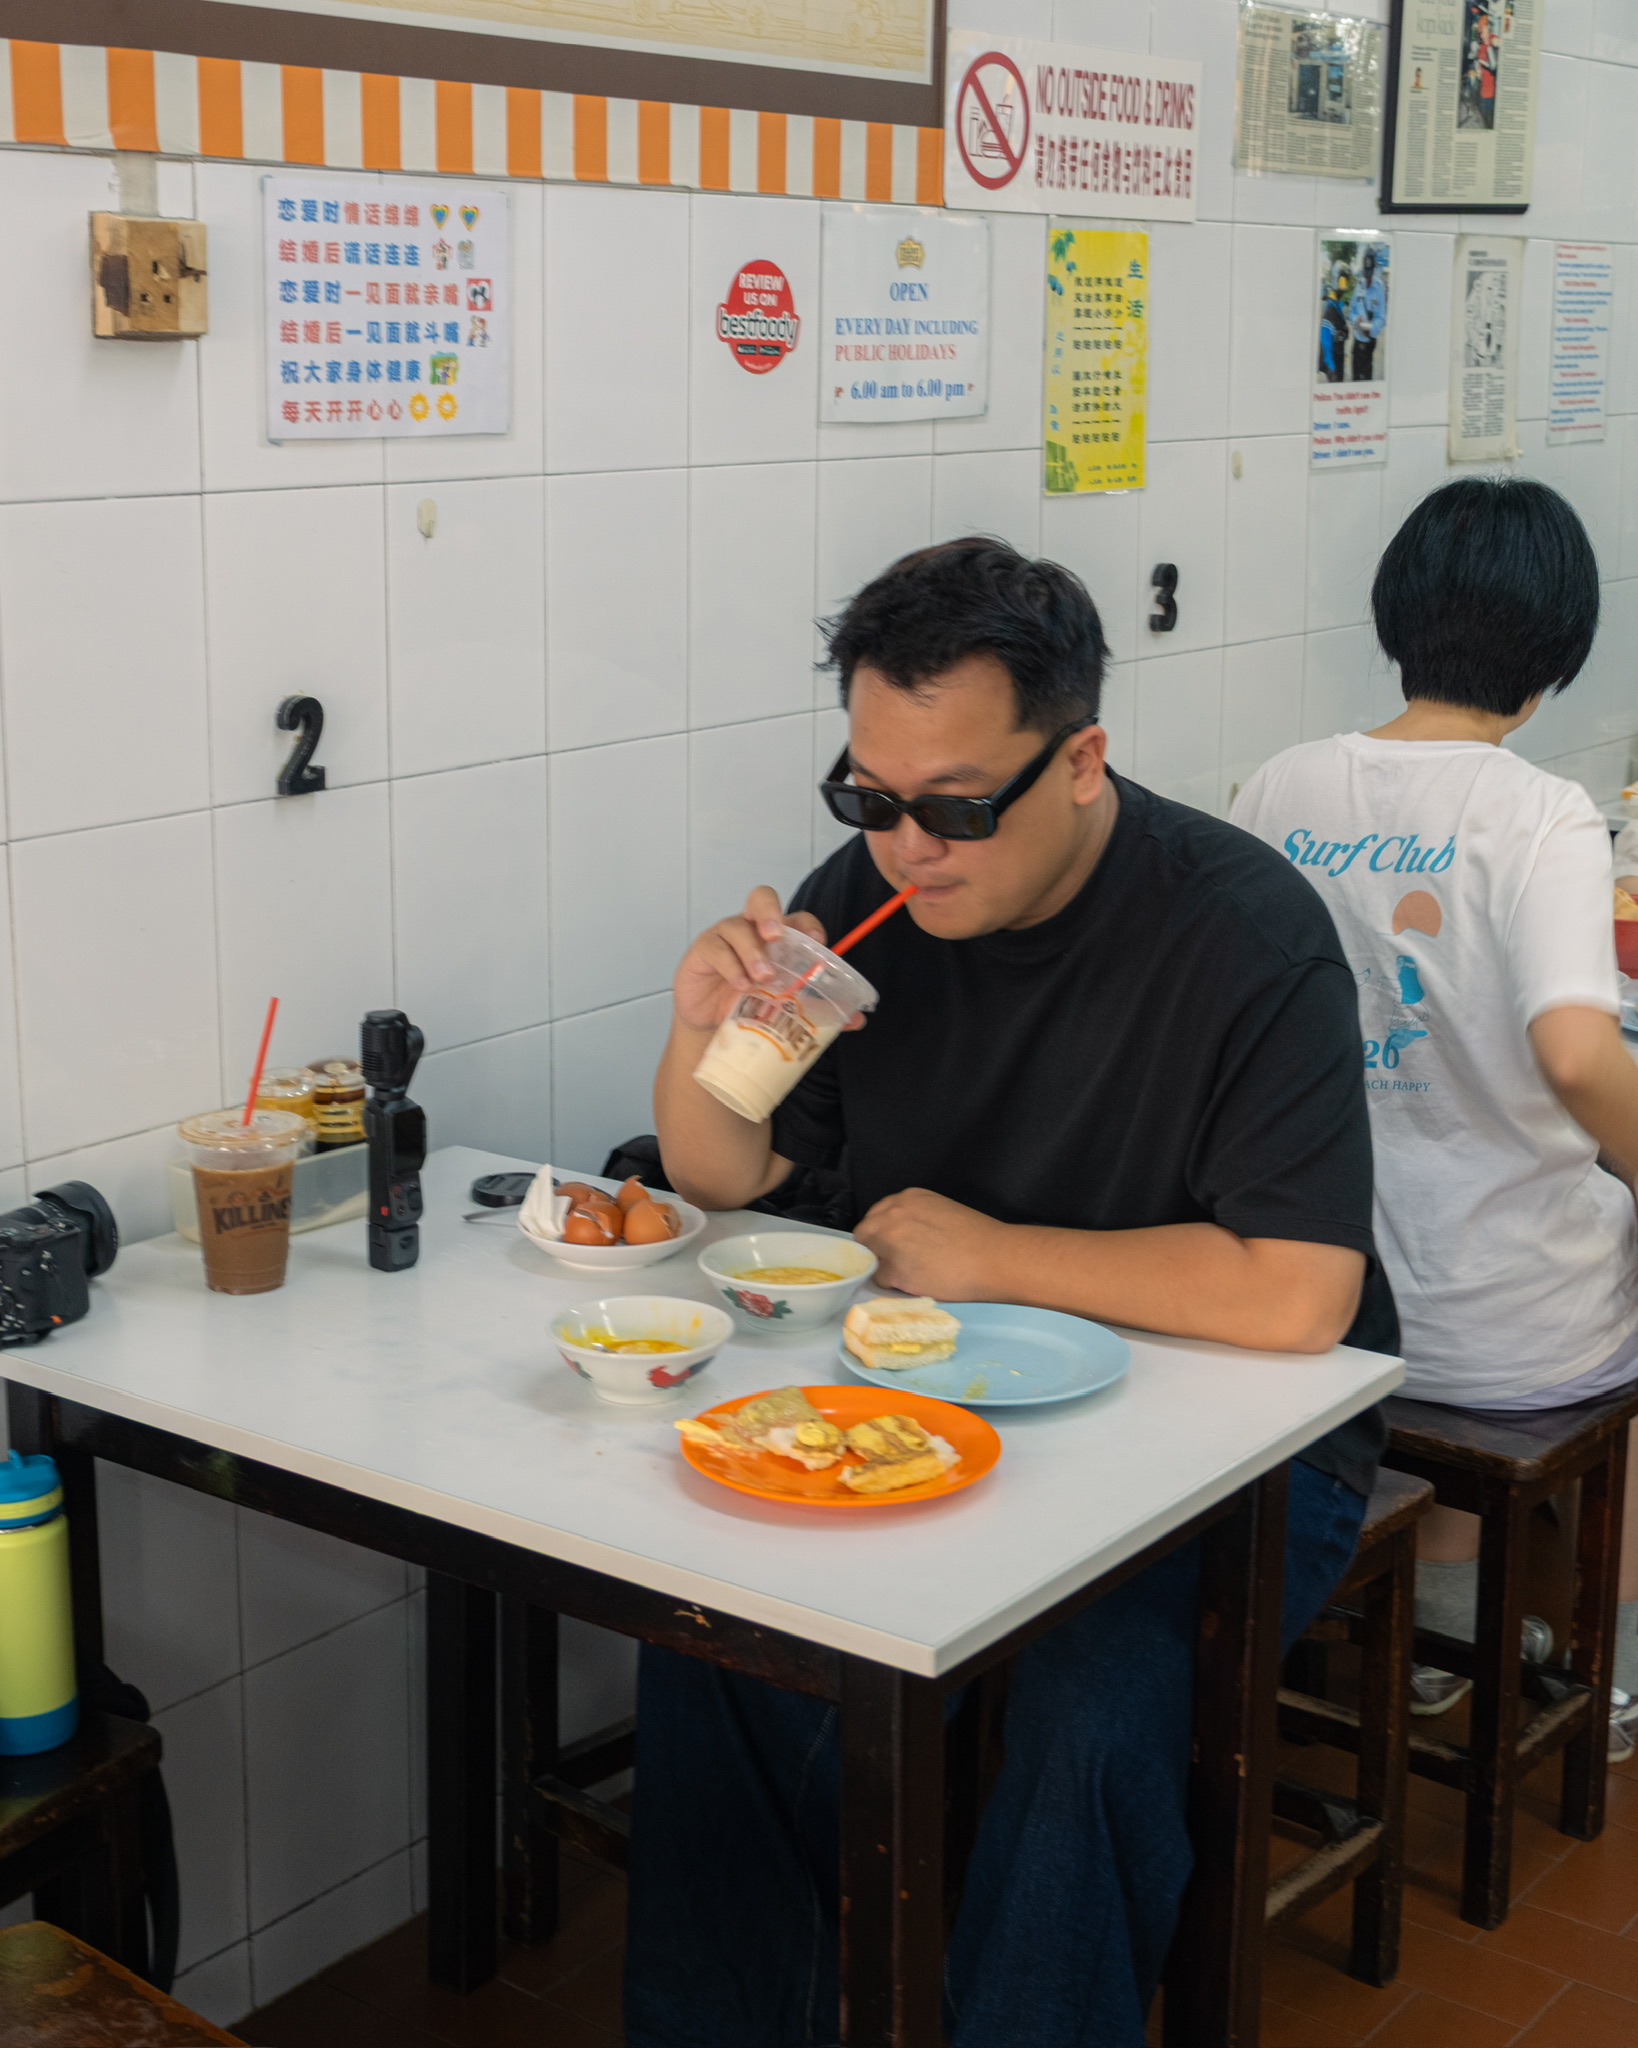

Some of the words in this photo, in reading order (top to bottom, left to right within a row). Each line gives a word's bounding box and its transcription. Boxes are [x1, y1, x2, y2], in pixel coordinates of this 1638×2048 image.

[1036, 64, 1054, 114] NO
[1056, 68, 1108, 121] OUTSIDE
[1109, 74, 1141, 125] FOOD
[1143, 79, 1152, 126] &
[1154, 80, 1196, 130] DRINKS
[279, 279, 460, 306] 恋爱时一见面就亲嘴
[738, 272, 785, 291] REVIEW
[889, 282, 929, 301] OPEN
[743, 291, 759, 305] US
[759, 294, 778, 307] ON
[279, 319, 460, 344] 结婚后一见面就斗嘴
[720, 308, 798, 346] bestfoody
[834, 317, 882, 336] EVERY
[885, 318, 912, 336] DAY
[914, 320, 978, 336] INCLUDING
[834, 344, 888, 362] PUBLIC
[888, 344, 957, 361] HOLIDAYS
[280, 359, 421, 384] 祝大家身体健康
[850, 380, 877, 400] 6.00
[880, 383, 899, 398] am
[901, 381, 914, 398] to
[916, 379, 942, 397] 6.00
[945, 381, 965, 401] pm
[282, 398, 403, 424] 每天开开心心
[1149, 563, 1179, 633] 3
[275, 694, 327, 796] 2
[1283, 828, 1379, 878] Surf
[1368, 833, 1456, 875] Club
[1392, 1080, 1431, 1092] HAPPY
